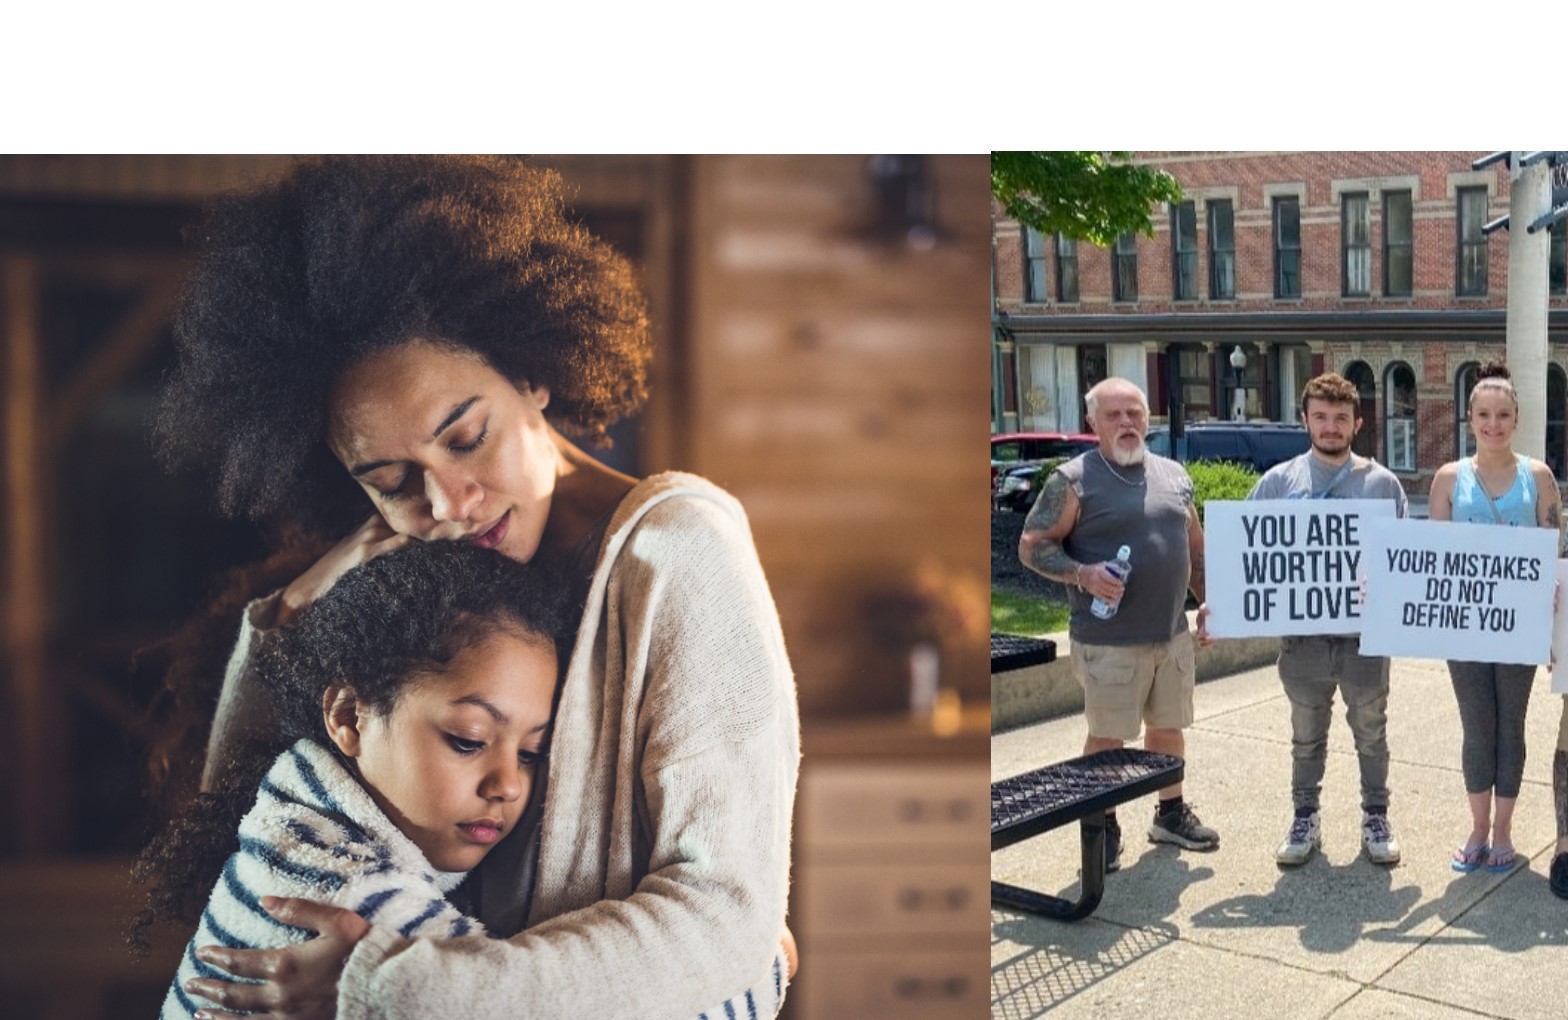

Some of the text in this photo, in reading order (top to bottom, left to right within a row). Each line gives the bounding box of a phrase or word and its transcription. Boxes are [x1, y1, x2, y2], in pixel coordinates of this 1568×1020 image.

[1242, 513, 1360, 548] YOU ARE
[1243, 550, 1361, 585] WORTHY
[1386, 548, 1541, 581] YOUR MISTAKES
[1243, 586, 1360, 621] OF LOVE
[1425, 578, 1498, 605] DO NOT
[1402, 602, 1516, 632] DEFINE YOU
